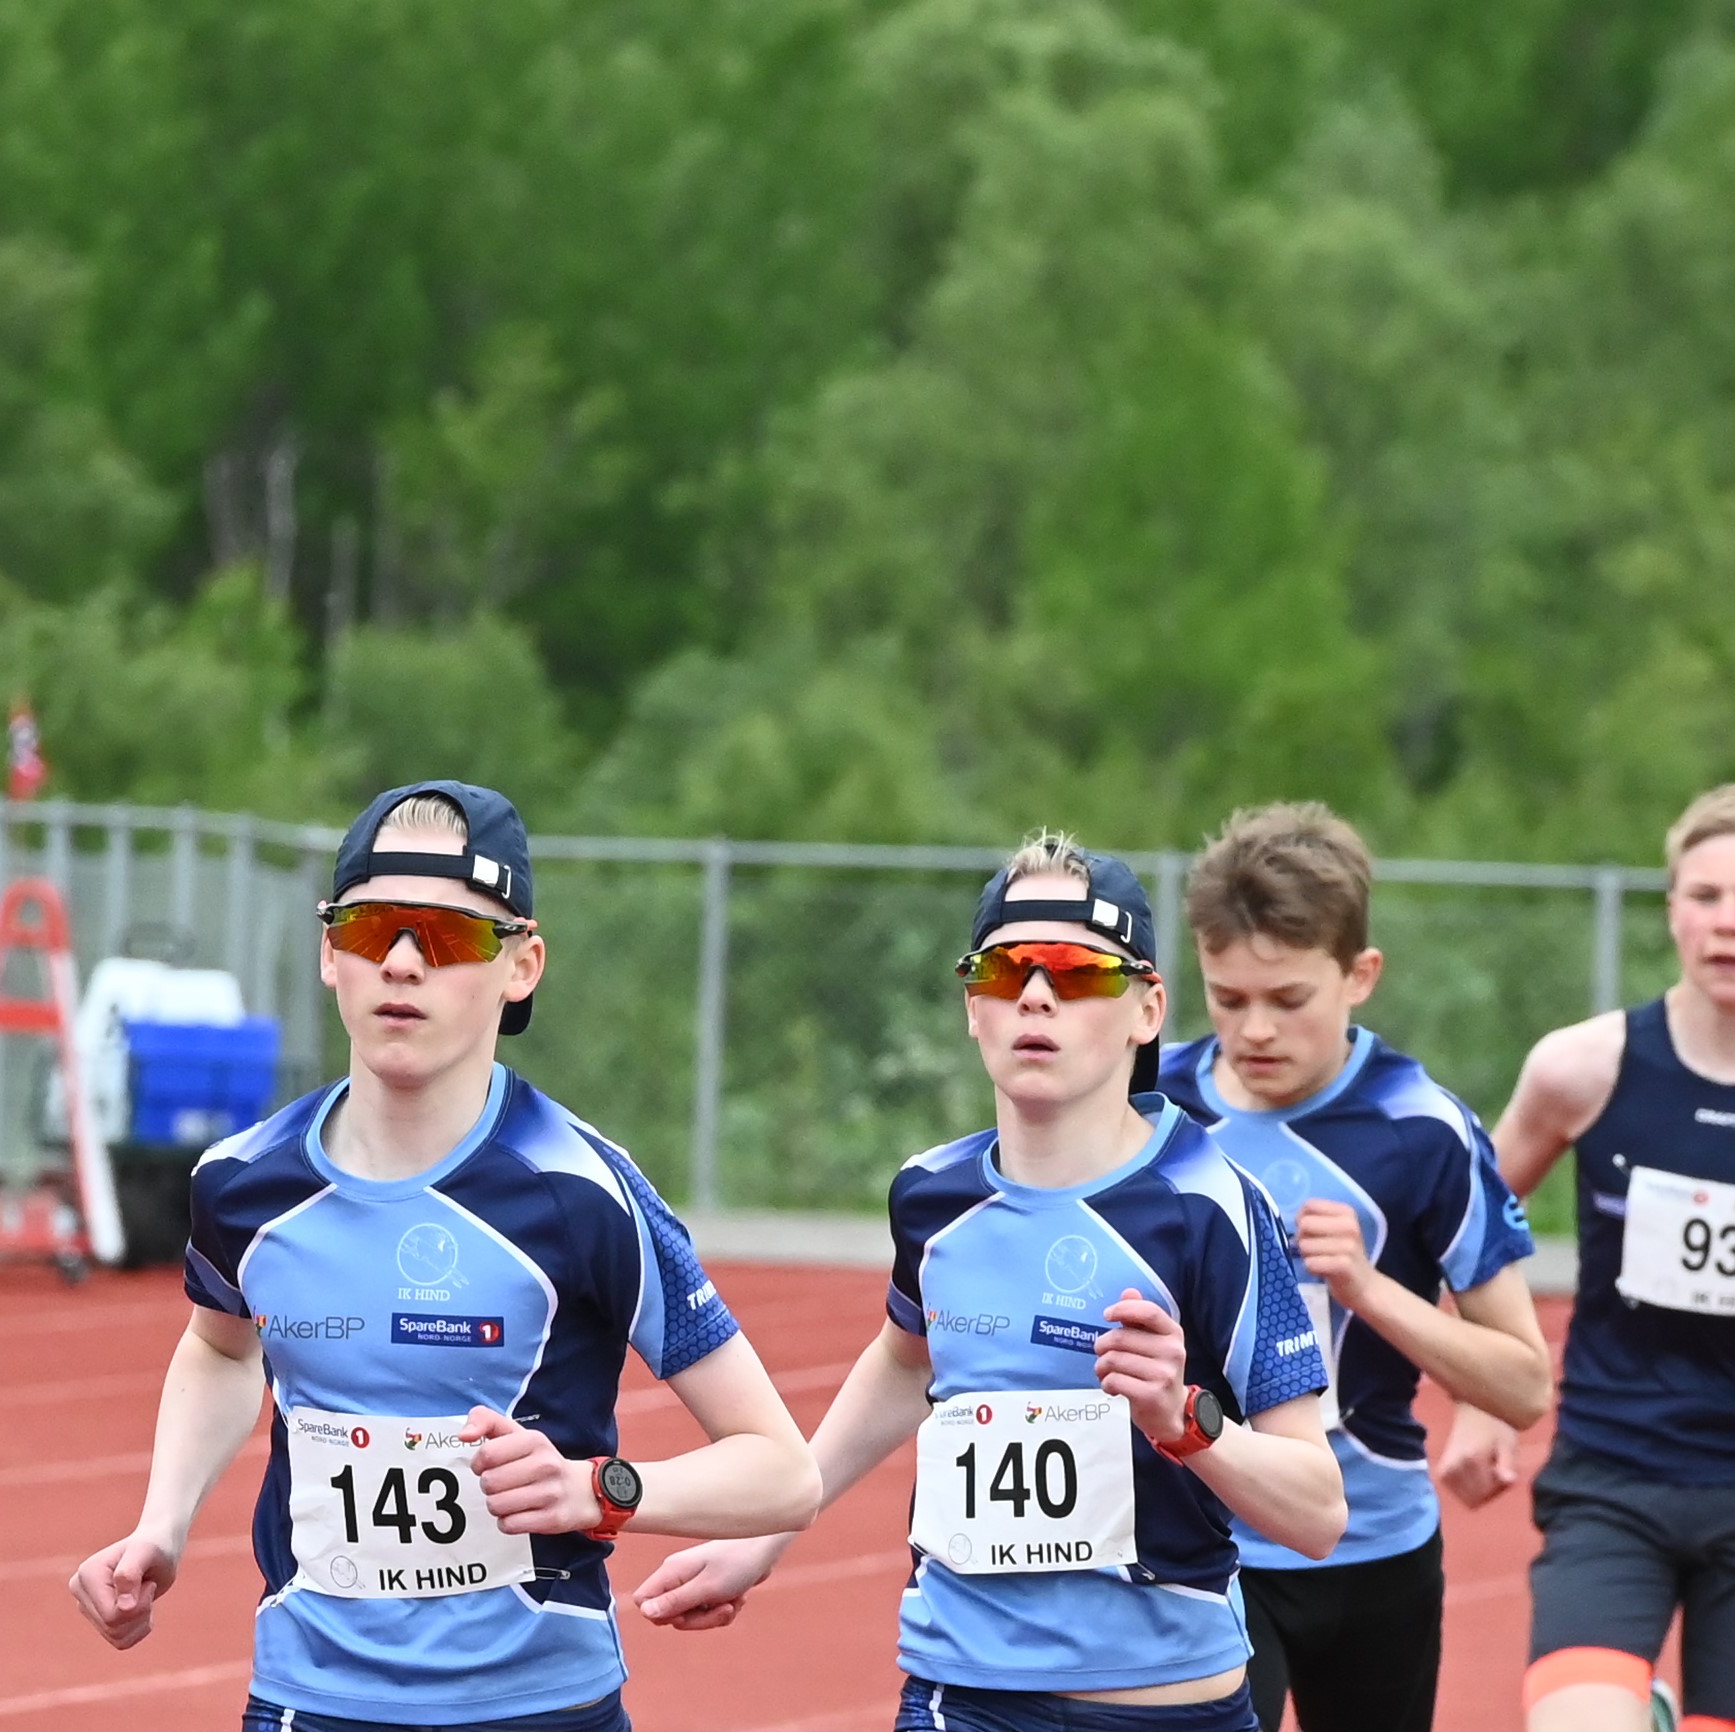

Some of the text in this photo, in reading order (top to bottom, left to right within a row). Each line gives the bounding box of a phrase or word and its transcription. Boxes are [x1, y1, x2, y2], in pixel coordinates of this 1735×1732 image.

[398, 1287, 451, 1302] IK HIND
[1041, 1292, 1087, 1310] IK HIND
[267, 1314, 366, 1340] AkerBP
[399, 1317, 472, 1334] SpareBank
[934, 1308, 1010, 1337] AkerBP
[1276, 1330, 1319, 1358] TRIM
[1044, 1403, 1111, 1422] AkerBP
[297, 1418, 349, 1439] SpareBank
[956, 1438, 1078, 1519] 140
[330, 1464, 467, 1545] 143
[991, 1541, 1093, 1566] IK HIND
[379, 1562, 488, 1591] IK HIND
